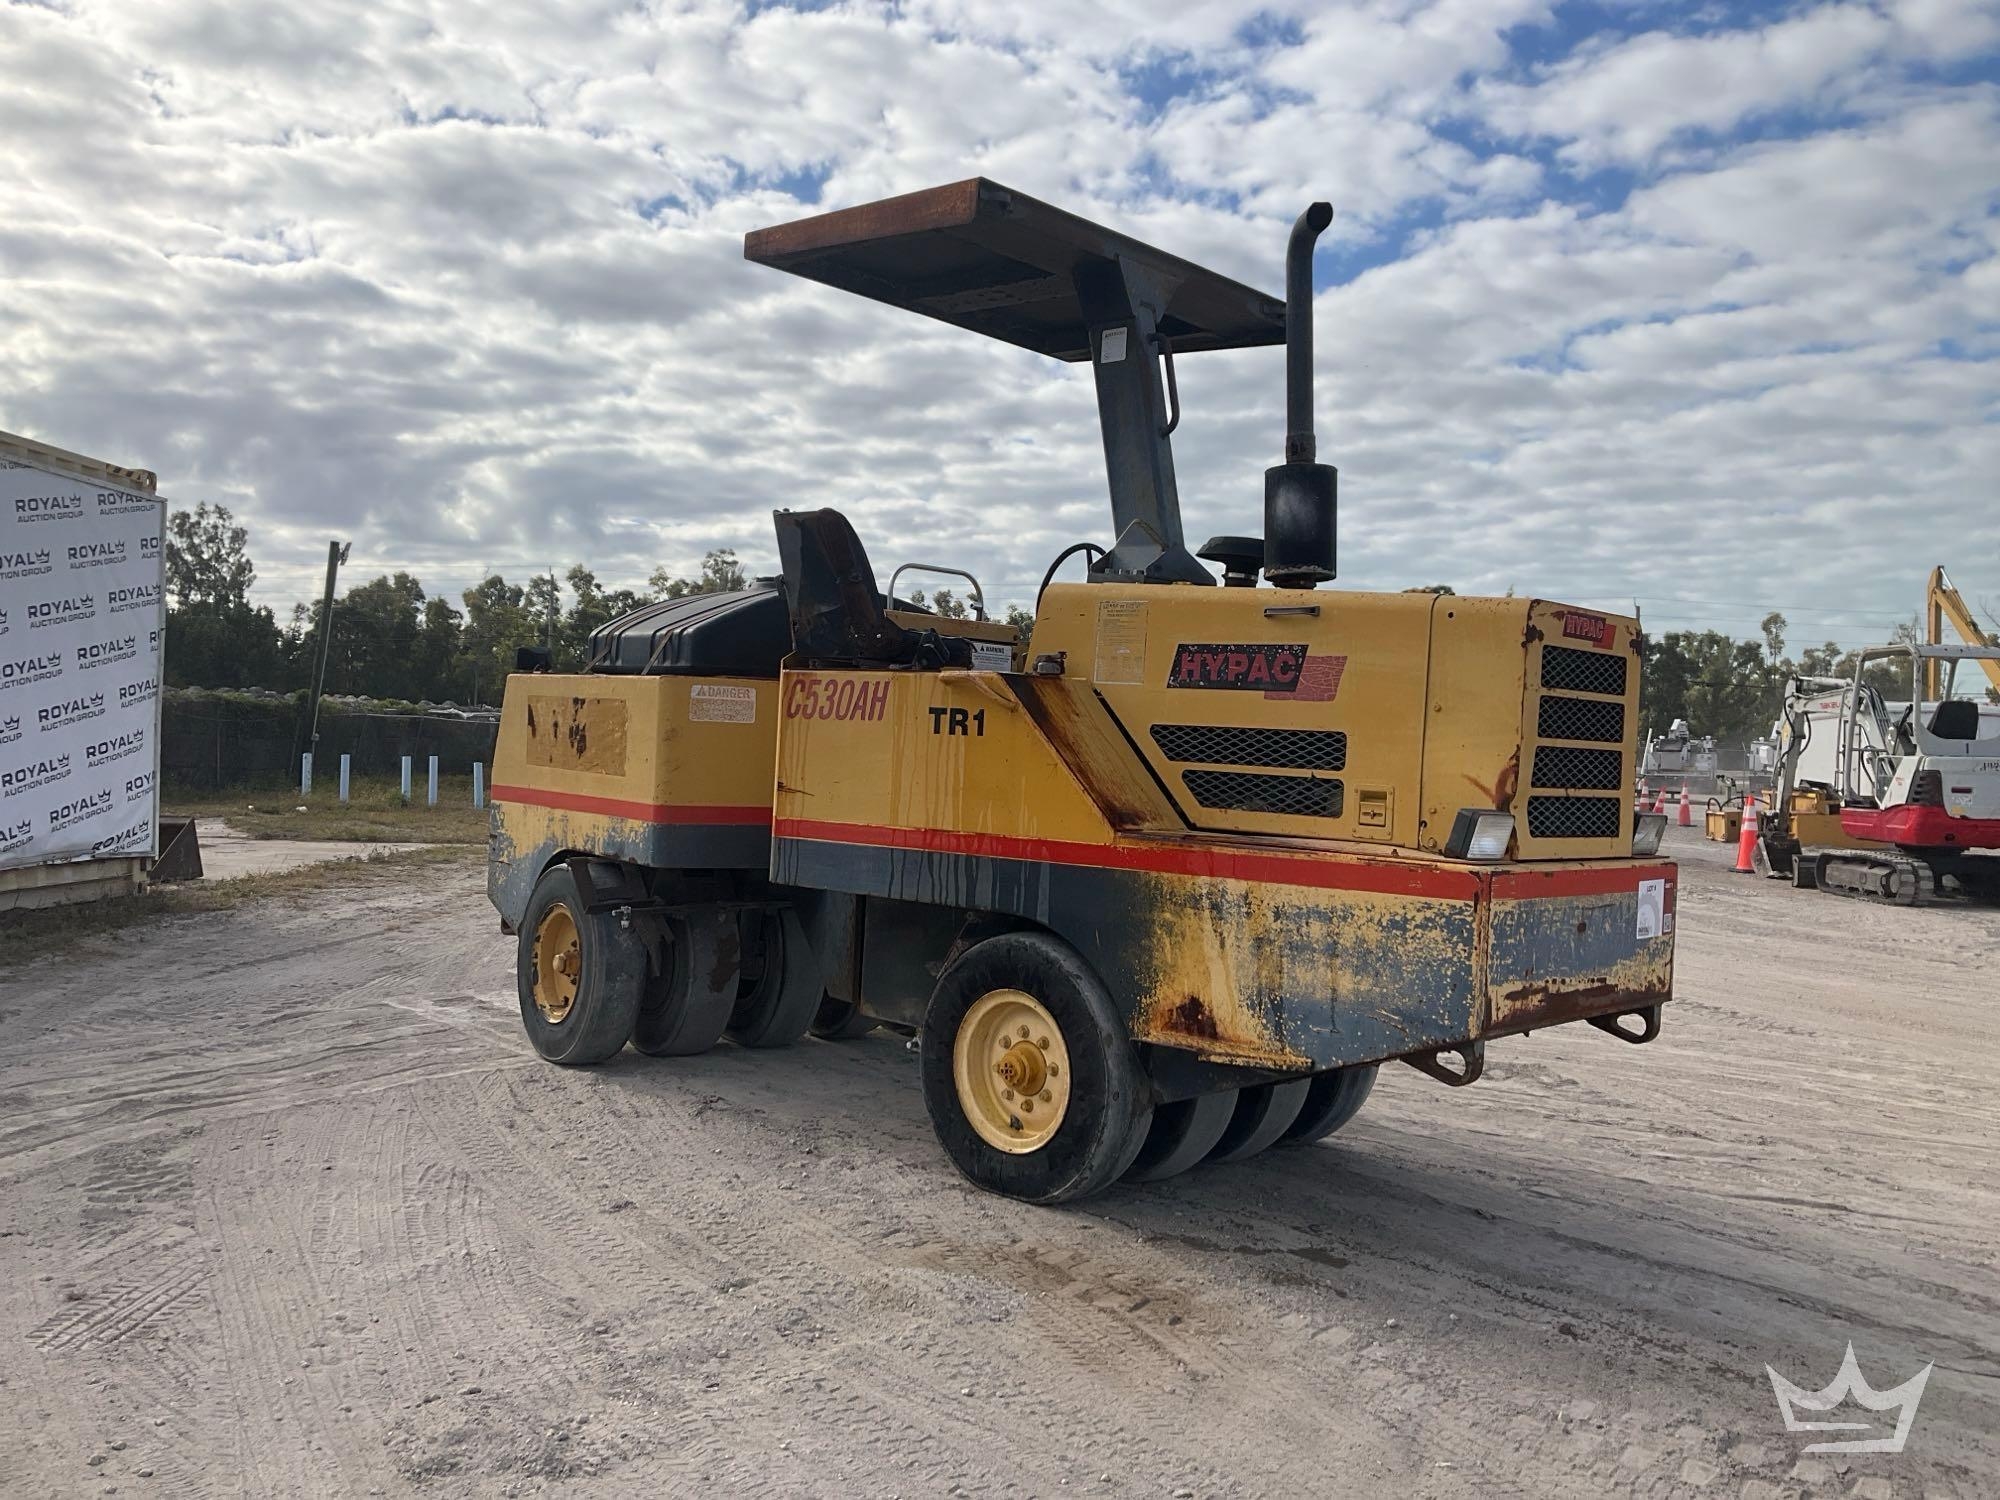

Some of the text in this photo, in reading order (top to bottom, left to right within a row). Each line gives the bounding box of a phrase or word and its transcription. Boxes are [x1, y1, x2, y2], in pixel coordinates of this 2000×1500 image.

[15, 496, 70, 512] ROYAL
[99, 504, 155, 515] AUCTION GROUP
[17, 510, 83, 523] AUCTION GROUP
[0, 552, 36, 569] YAL
[67, 542, 115, 560] ROYAL
[70, 555, 127, 569] AUCTION GROUP
[0, 565, 53, 580] TION GROUP
[108, 585, 153, 604] ROYAL
[28, 598, 80, 619] ROYAL
[110, 601, 141, 613] AUCTION
[30, 610, 96, 629] AUCTION GROUP
[1564, 615, 1604, 639] HYPAC
[77, 639, 124, 661] ROYAL
[79, 650, 137, 671] AUCTION GROUP
[0, 657, 48, 679] OYAL
[1179, 652, 1297, 683] HYPAC
[0, 668, 63, 690] UCTION GROUP
[119, 678, 158, 700] ROYAL
[120, 694, 147, 709] AUCTION
[708, 686, 751, 699] DANGER
[786, 679, 891, 721] C530AH
[38, 697, 90, 723] ROYAL
[40, 708, 106, 732] AUCTION GROUP
[928, 707, 985, 736] TR1
[86, 733, 134, 759] ROYAL
[87, 743, 144, 769] AUCTION GROUP
[1, 759, 58, 788] ROYAL
[4, 769, 72, 798] AUCTION GROUP
[125, 770, 156, 794] ROY
[49, 795, 98, 824] ROYAL
[50, 803, 114, 833] AUCTION GROUP
[2, 835, 34, 853] GROUP
[91, 825, 138, 851] ROYAL
[126, 832, 150, 849] GROUP
